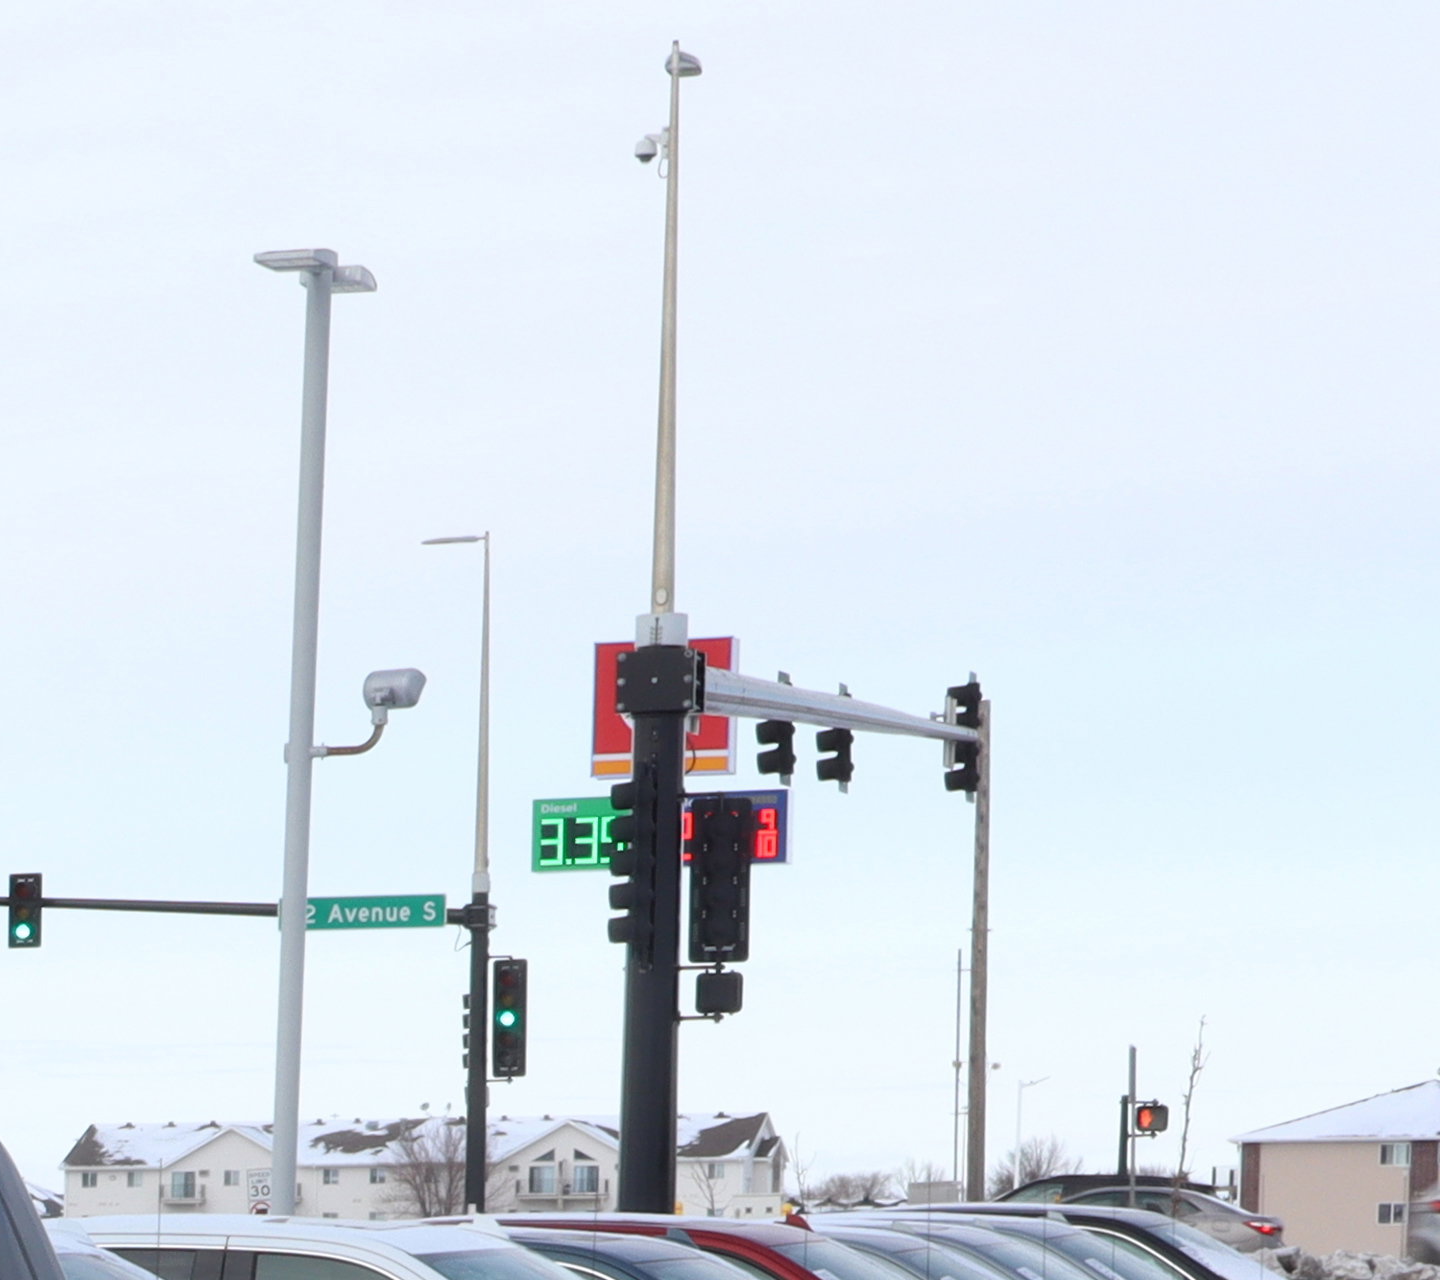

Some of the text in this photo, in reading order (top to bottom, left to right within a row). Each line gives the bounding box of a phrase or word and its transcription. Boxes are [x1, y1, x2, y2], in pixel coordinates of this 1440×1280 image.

[541, 802, 578, 814] Diesel
[327, 903, 411, 924] Avenue
[423, 901, 437, 922] S
[251, 1184, 271, 1197] 30
